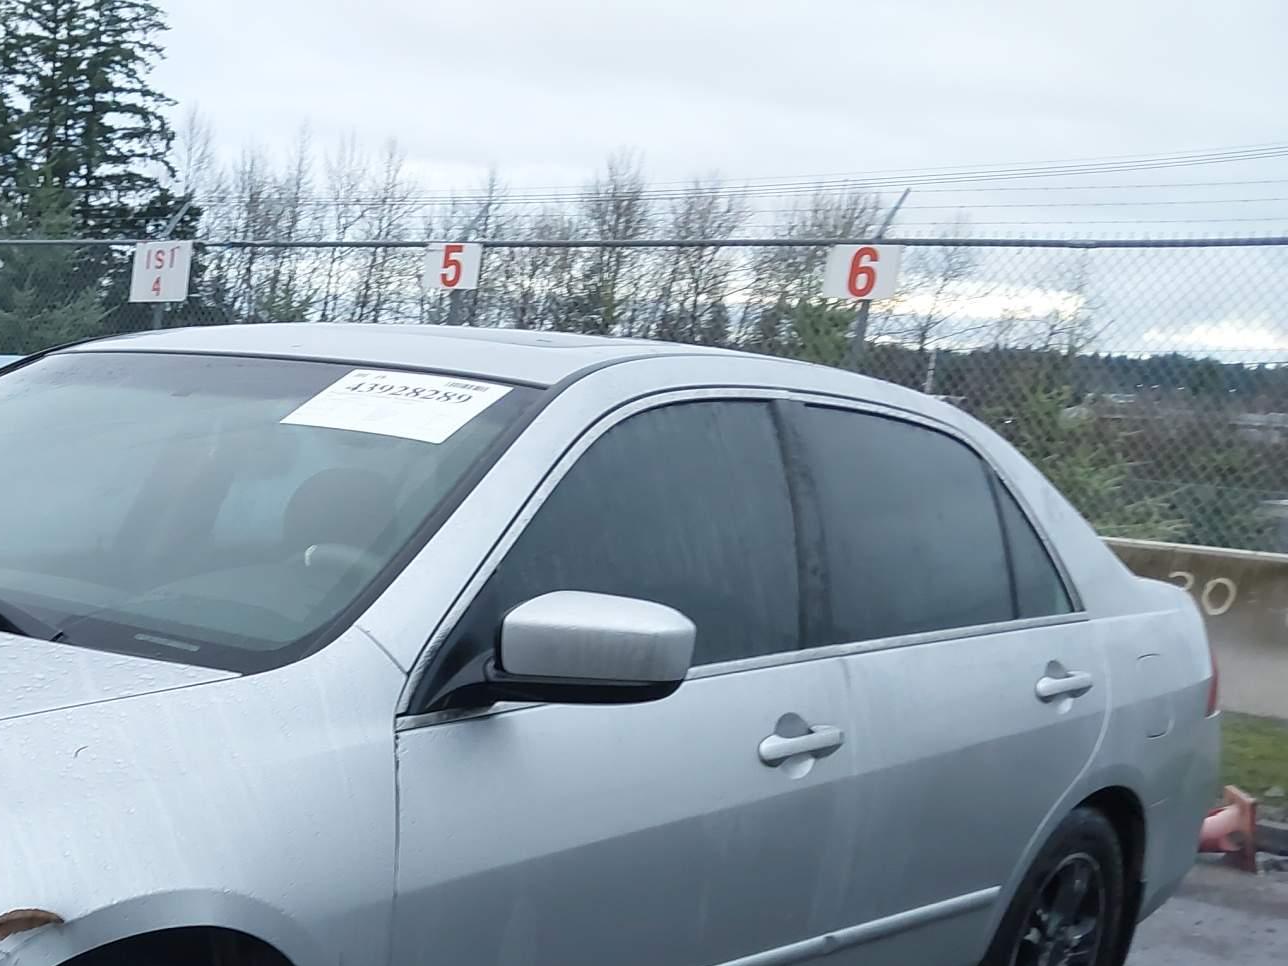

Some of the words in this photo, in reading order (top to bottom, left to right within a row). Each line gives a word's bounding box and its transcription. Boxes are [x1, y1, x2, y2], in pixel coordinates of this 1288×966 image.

[440, 244, 464, 288] 5
[847, 246, 879, 298] 6
[152, 276, 161, 297] 4
[345, 381, 474, 405] 43928289
